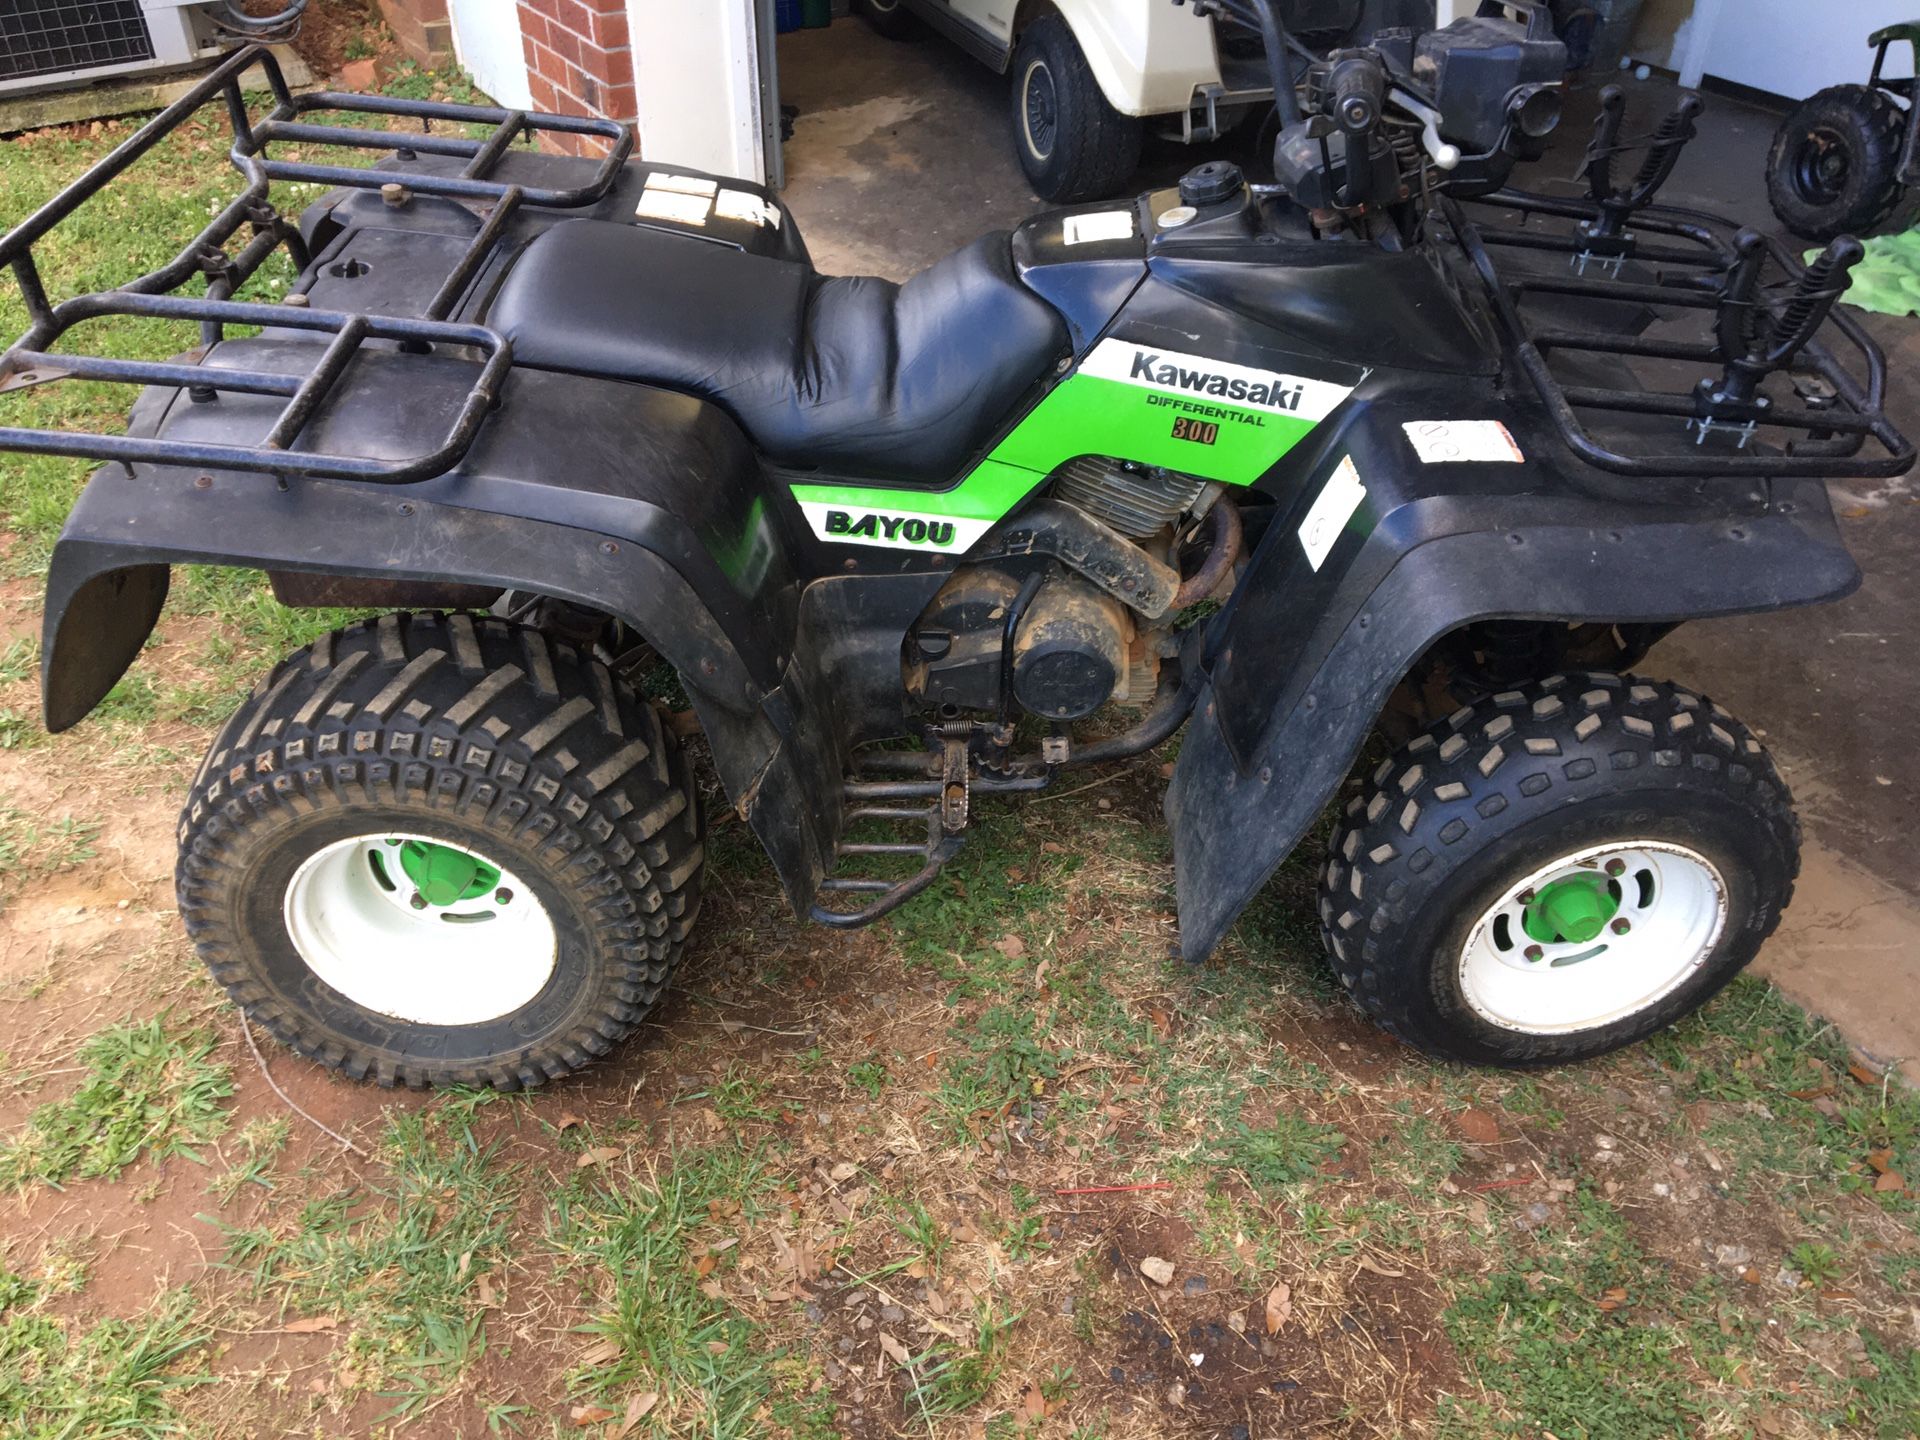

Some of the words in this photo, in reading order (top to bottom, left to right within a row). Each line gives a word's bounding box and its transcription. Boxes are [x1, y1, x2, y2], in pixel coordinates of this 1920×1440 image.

[1130, 351, 1303, 411] Kawasaki
[1147, 395, 1265, 427] DIFFERENTIAL
[1172, 417, 1218, 444] 300
[825, 510, 956, 545] BAYOU
